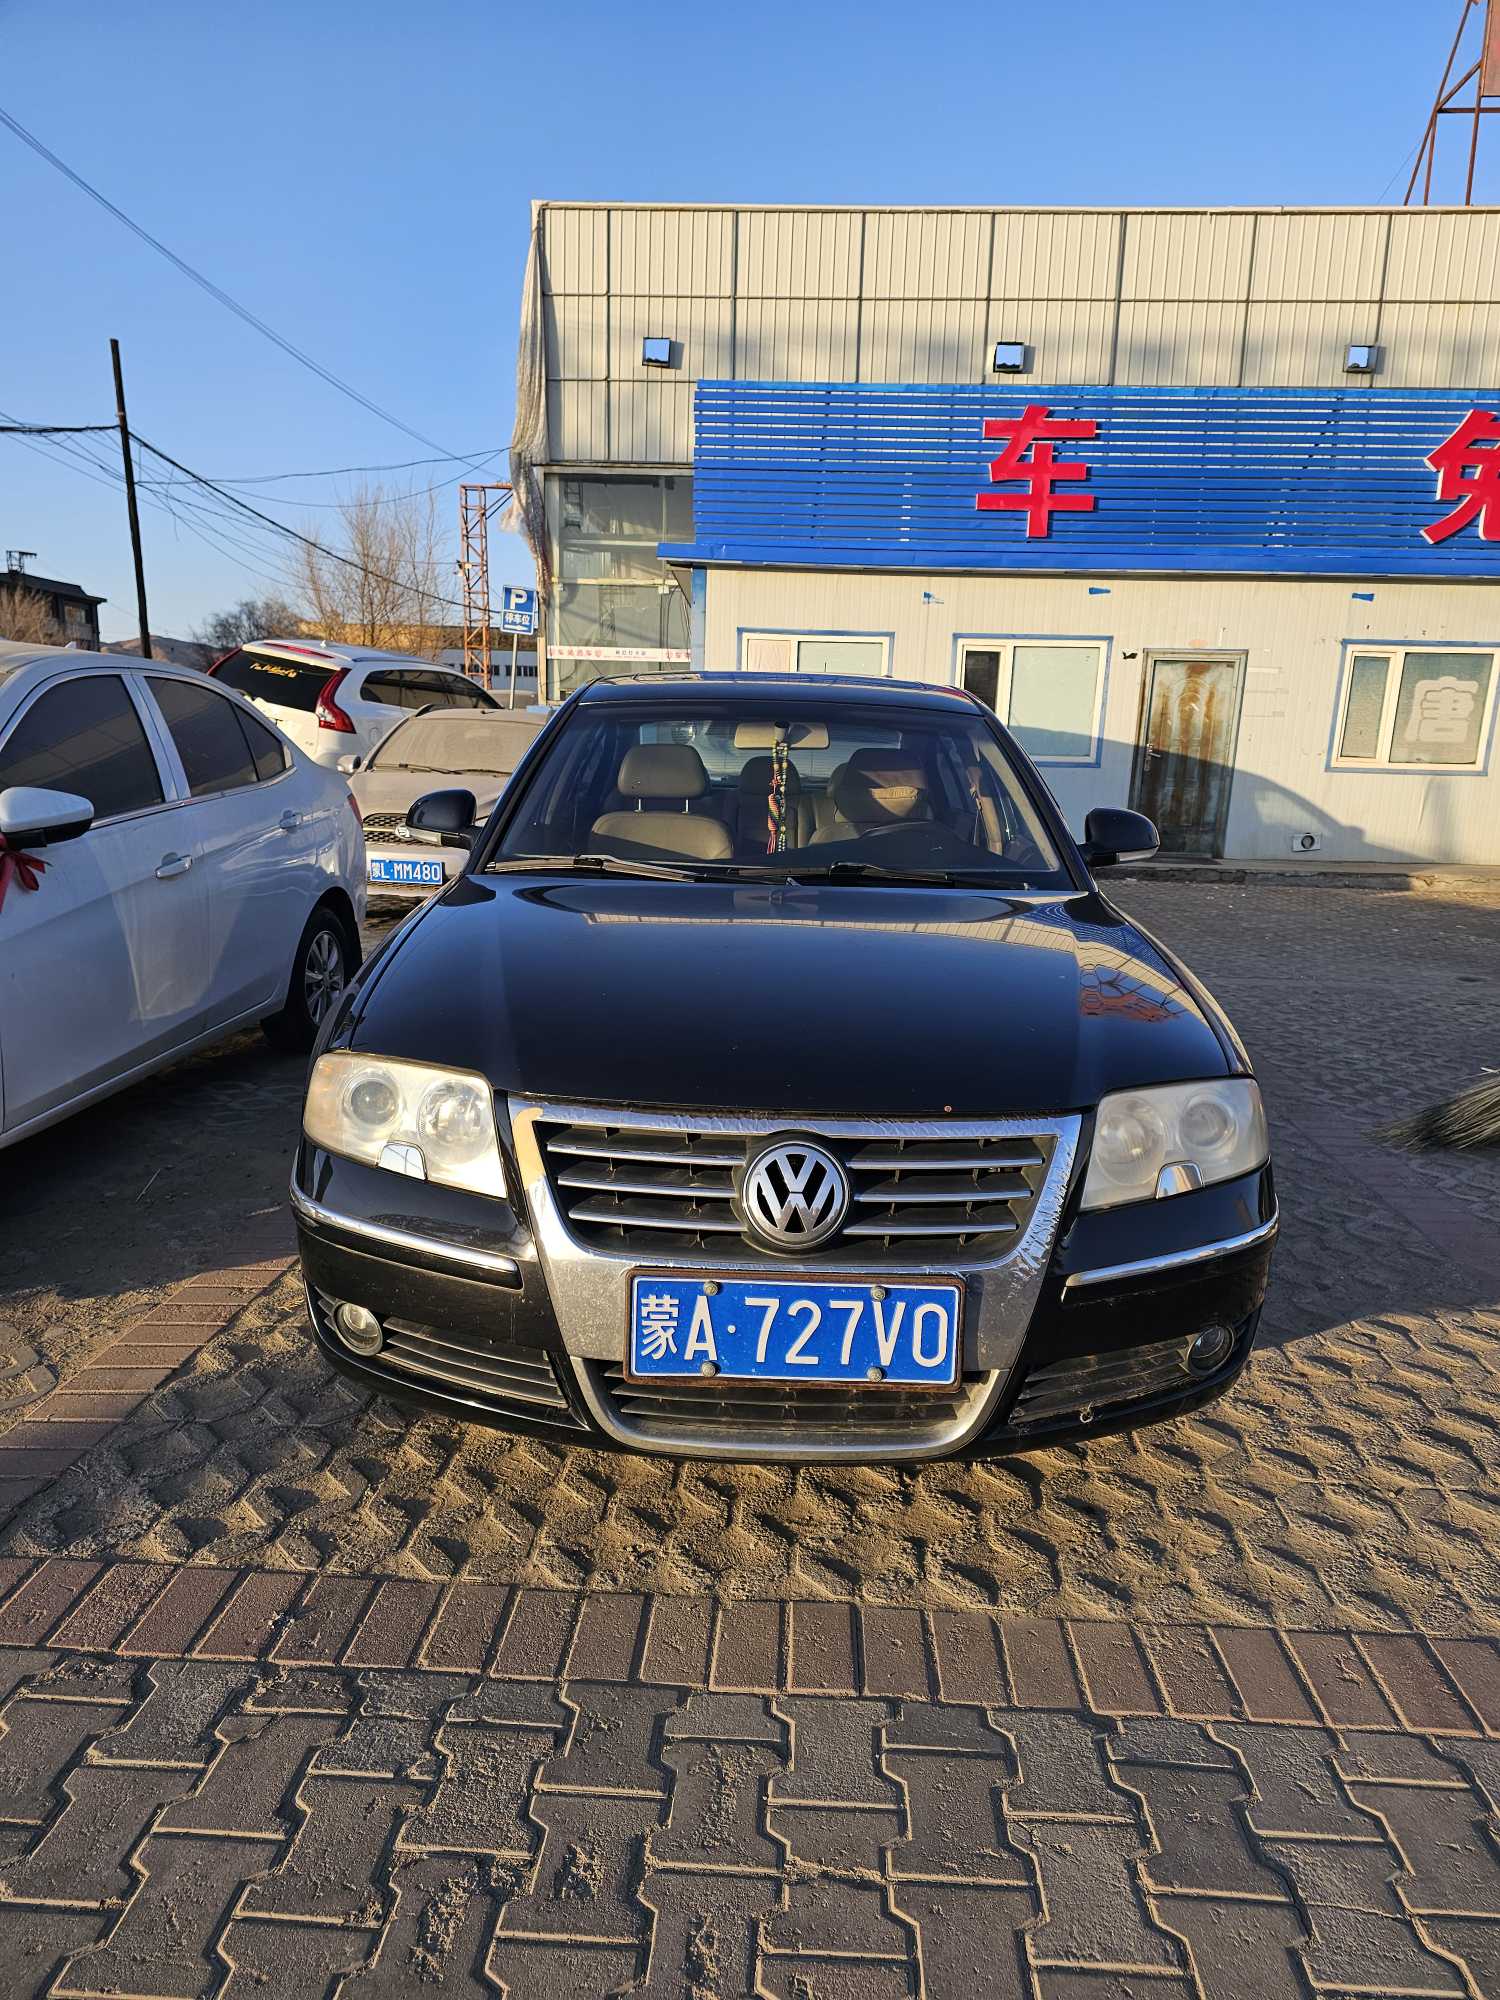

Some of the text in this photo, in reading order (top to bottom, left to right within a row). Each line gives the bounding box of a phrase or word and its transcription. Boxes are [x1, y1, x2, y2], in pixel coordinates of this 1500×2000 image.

[510, 588, 528, 610] P
[504, 612, 530, 625] 停车位
